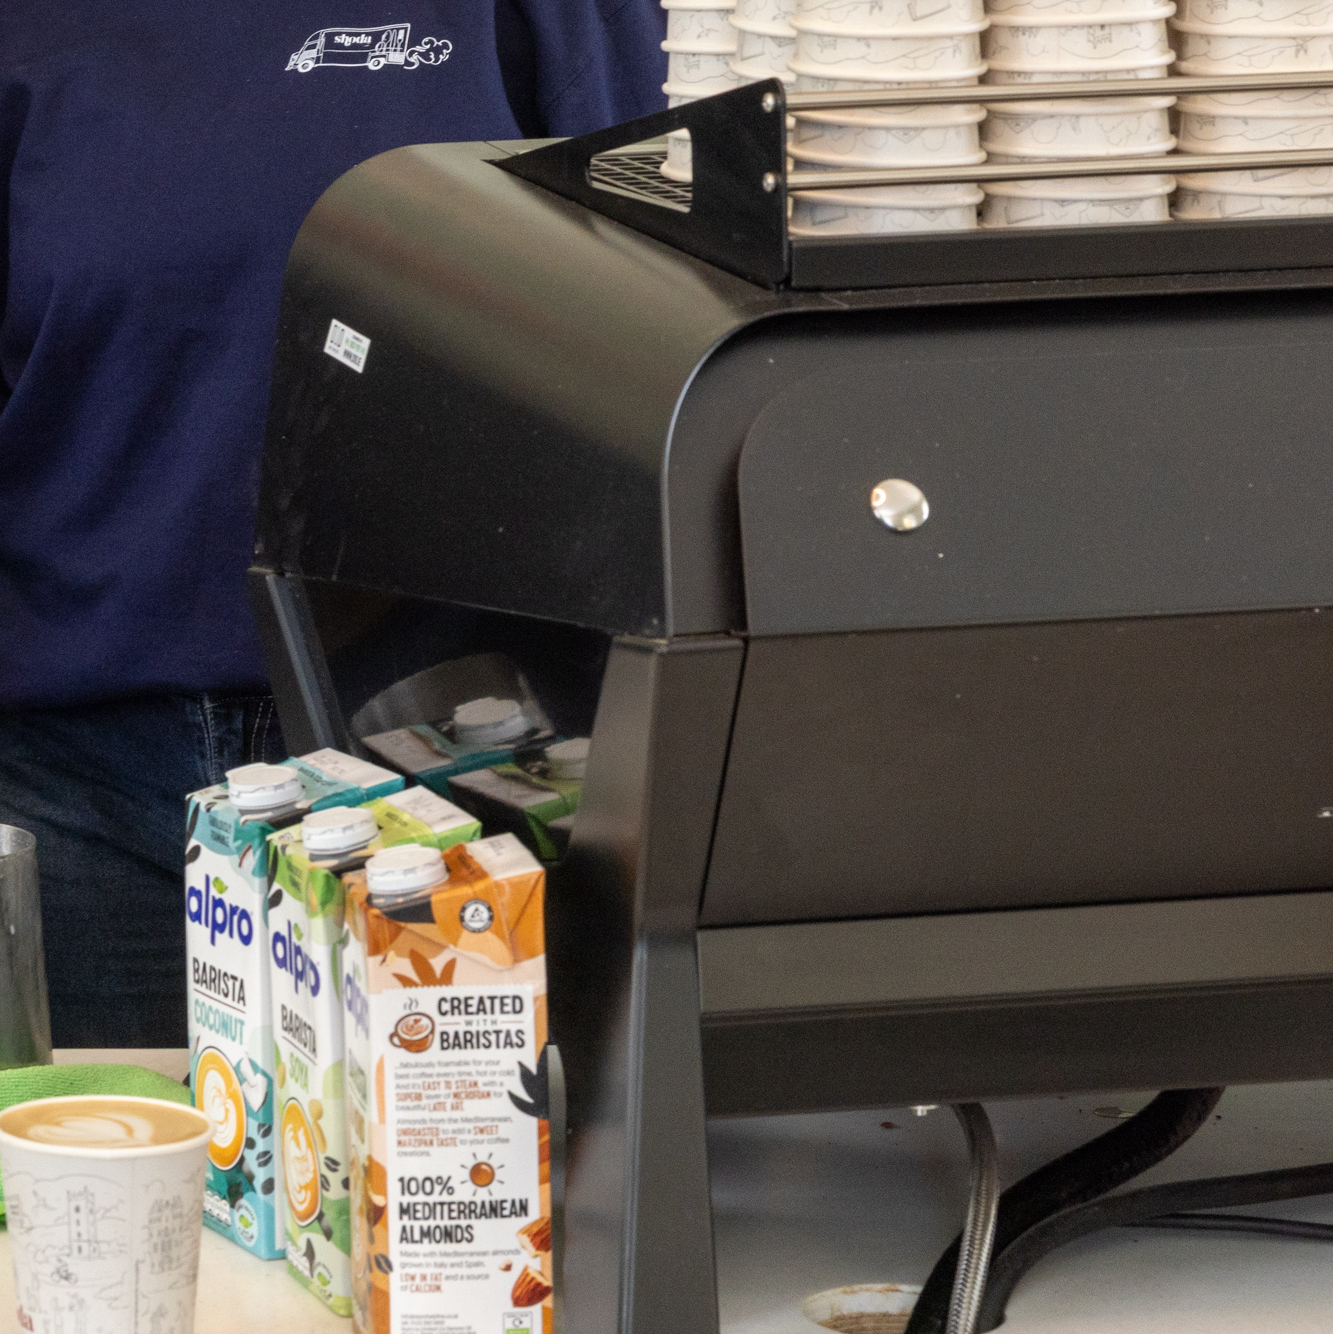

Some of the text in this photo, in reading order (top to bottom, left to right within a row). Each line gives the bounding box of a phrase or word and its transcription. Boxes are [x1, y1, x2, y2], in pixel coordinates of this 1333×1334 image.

[334, 34, 372, 46] shoda
[187, 874, 253, 946] alpro
[193, 957, 246, 1007] BARISTA
[438, 996, 523, 1016] CREATED
[194, 998, 245, 1045] COCONUT
[281, 1004, 317, 1058] BARISTA
[440, 1030, 525, 1050] BARISTAS
[289, 1052, 308, 1093] SOYA
[398, 1176, 455, 1196] 100%
[399, 1198, 528, 1221] MEDITERRANEAN
[399, 1225, 474, 1244] ALMONDS
